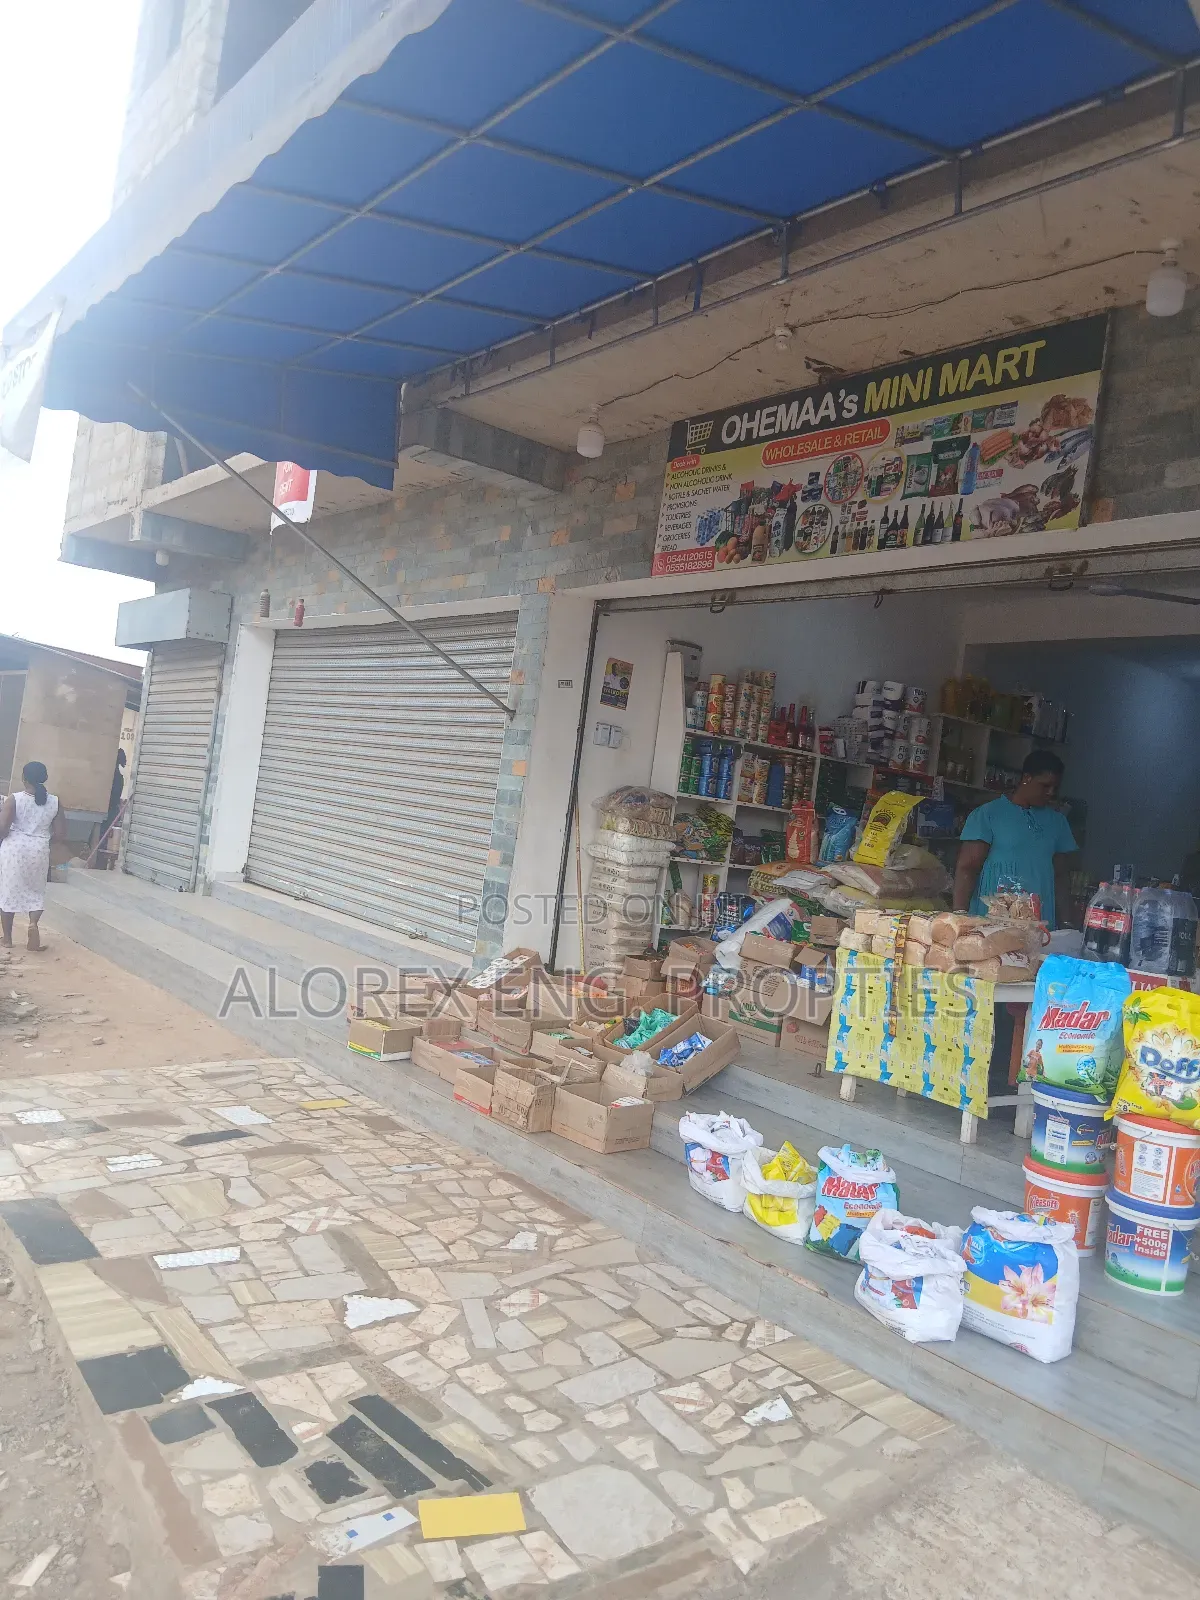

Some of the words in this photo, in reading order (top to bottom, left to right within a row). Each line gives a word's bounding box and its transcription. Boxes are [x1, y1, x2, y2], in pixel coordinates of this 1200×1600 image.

[721, 388, 859, 445] OHEMAA's
[863, 366, 933, 414] MINI
[938, 339, 1047, 397] MART
[765, 436, 833, 461] WHOLESALE
[833, 434, 842, 447] &
[843, 426, 885, 446] RETAIL
[666, 550, 713, 564] 0544120615
[1038, 1000, 1111, 1031] Madar
[1140, 1045, 1200, 1078] Doff
[1106, 1224, 1135, 1247] adar
[1136, 1225, 1169, 1240] FREE
[1134, 1236, 1168, 1250] +500g
[1134, 1244, 1166, 1257] Inside
